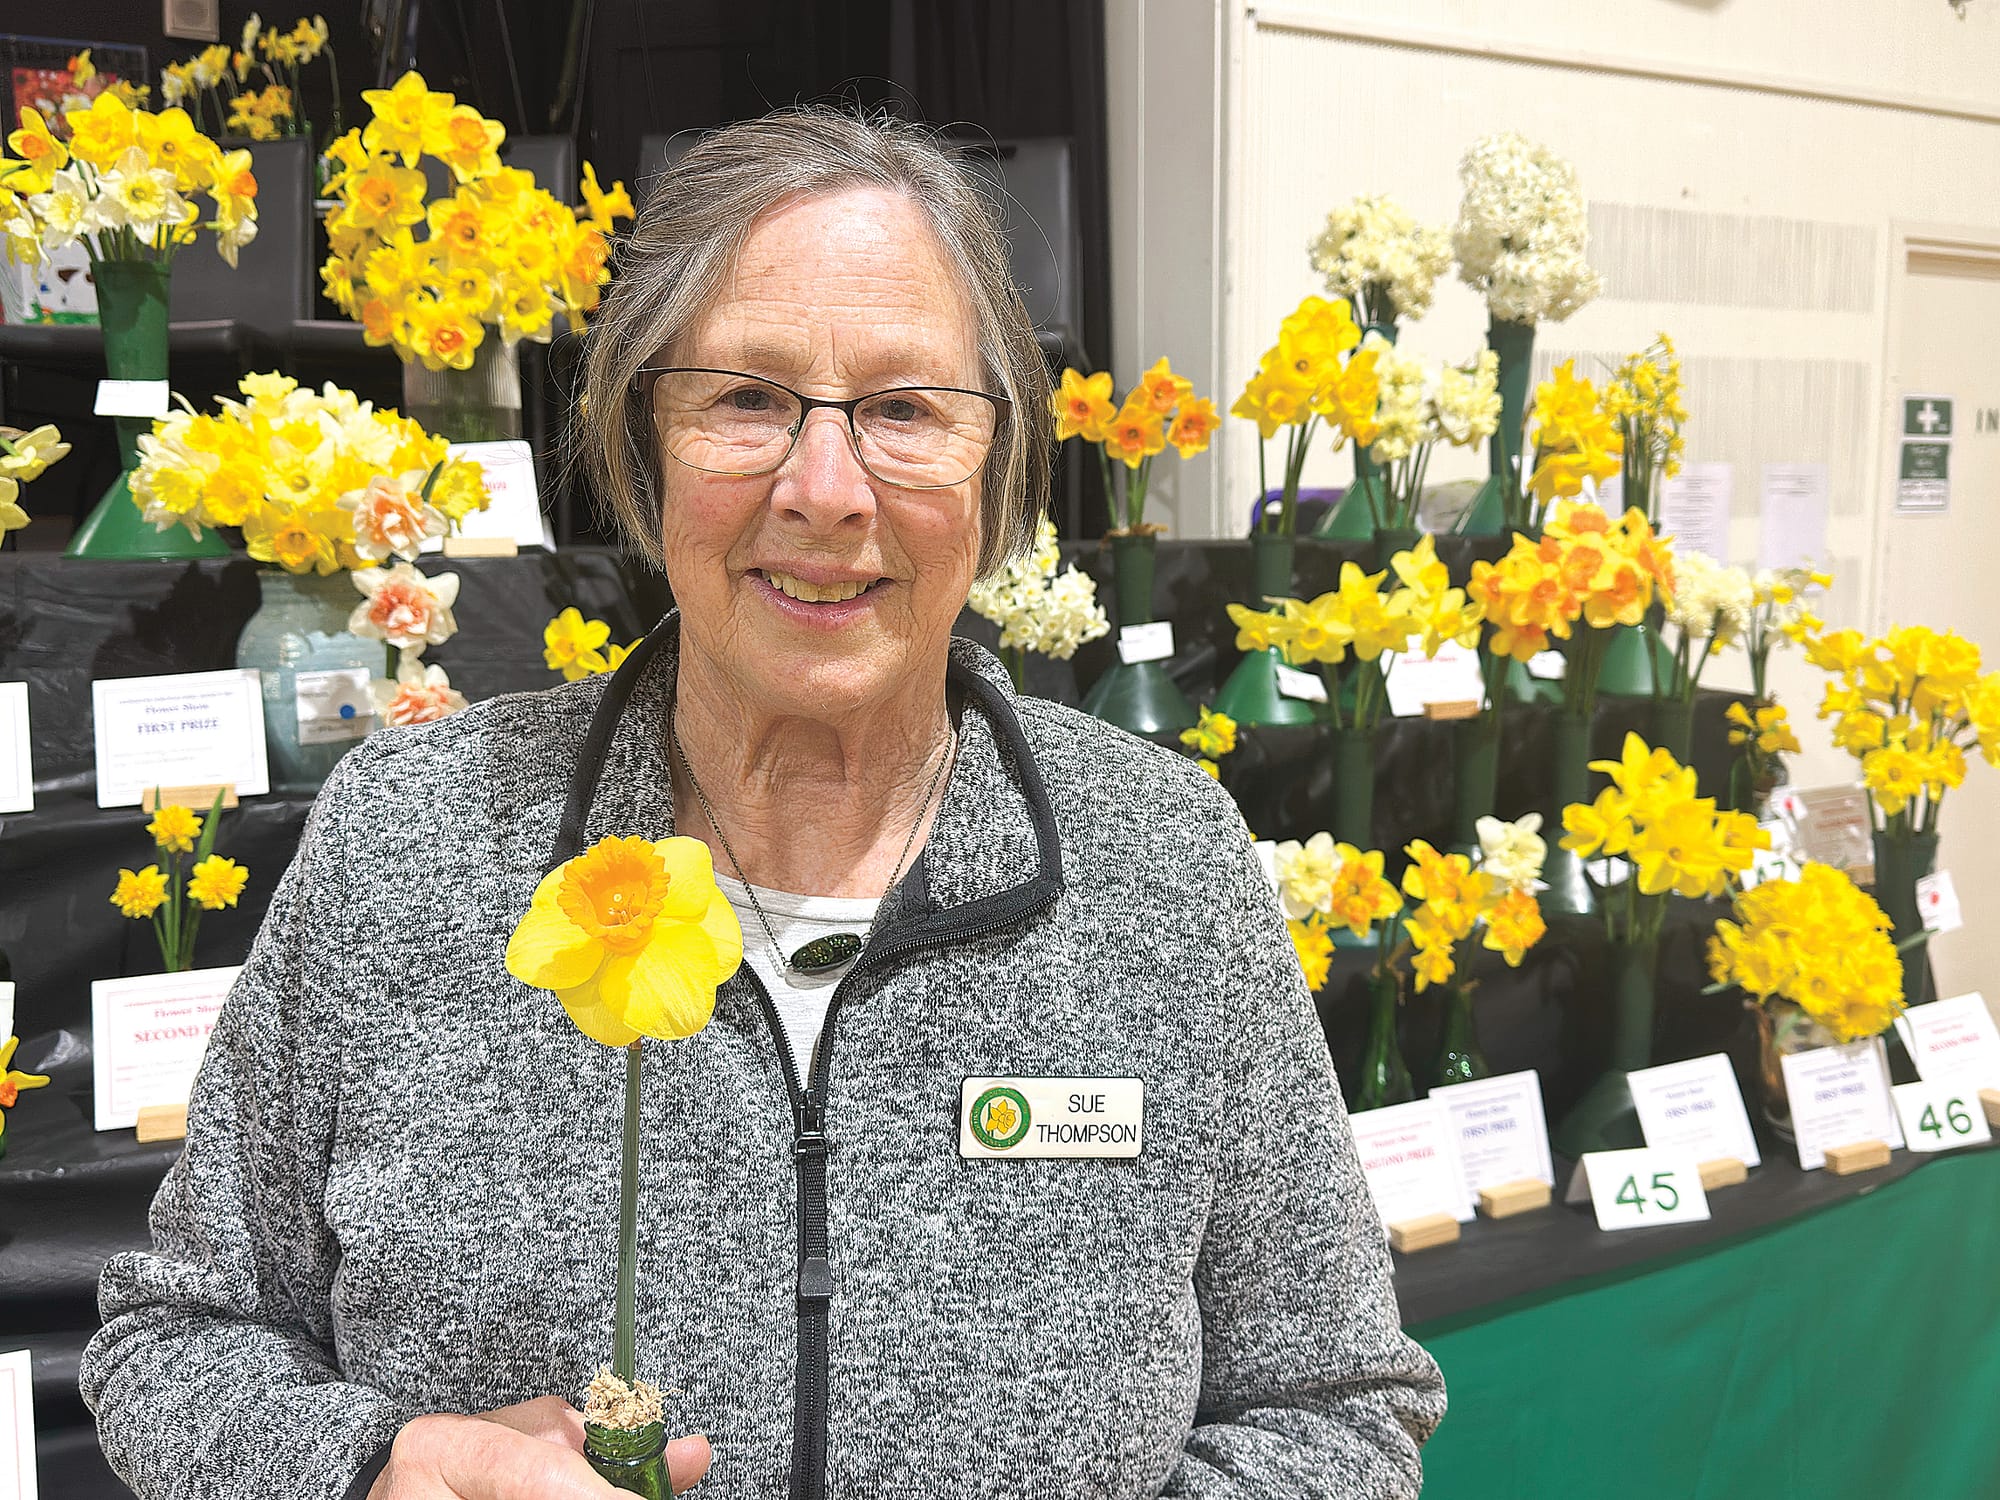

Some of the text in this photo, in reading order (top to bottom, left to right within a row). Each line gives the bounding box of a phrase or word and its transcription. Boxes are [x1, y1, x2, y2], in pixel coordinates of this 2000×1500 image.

[137, 719, 219, 734] FIRST PRIZE
[134, 1025, 200, 1043] SECOND
[1068, 1094, 1106, 1113] SUE
[1919, 1098, 1973, 1139] 46
[1036, 1124, 1137, 1143] THOMPSON
[1616, 1172, 1680, 1215] 45
